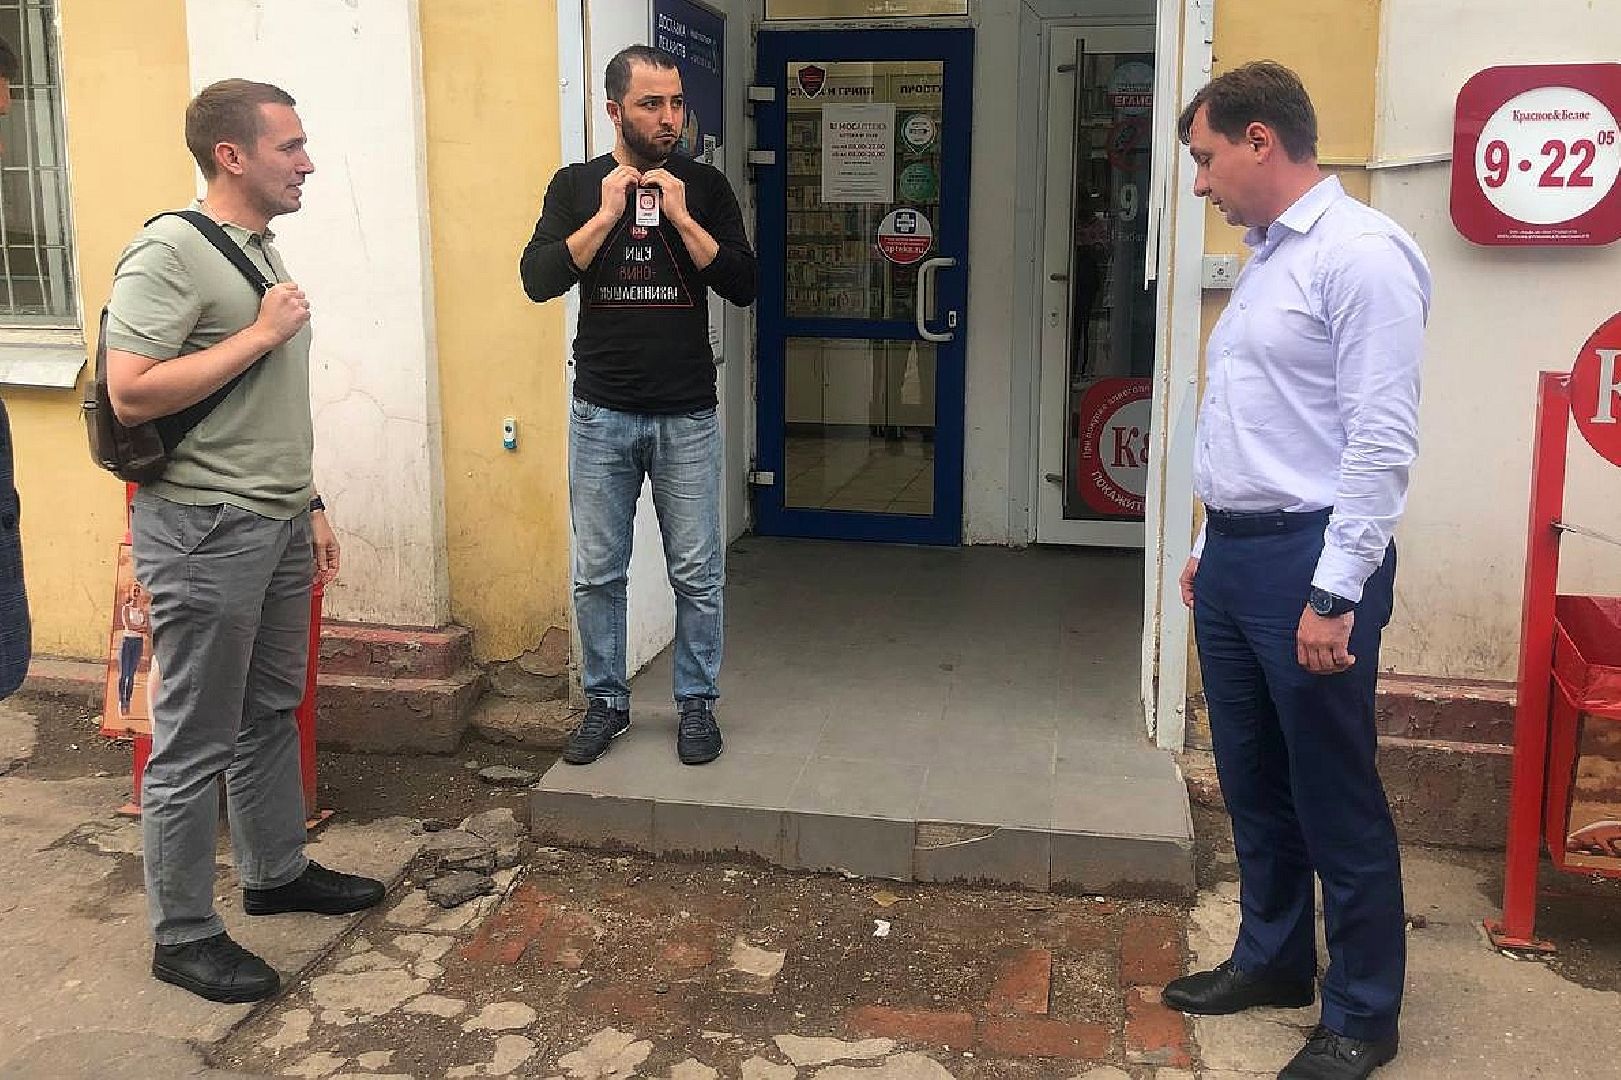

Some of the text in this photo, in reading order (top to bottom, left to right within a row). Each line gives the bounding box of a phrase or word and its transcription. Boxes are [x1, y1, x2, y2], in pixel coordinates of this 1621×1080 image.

[1512, 109, 1590, 122] Красное&Белое
[1597, 129, 1615, 146] 05
[625, 246, 652, 262] ИЩУ
[1091, 470, 1145, 511] ПОКАЖИТ
